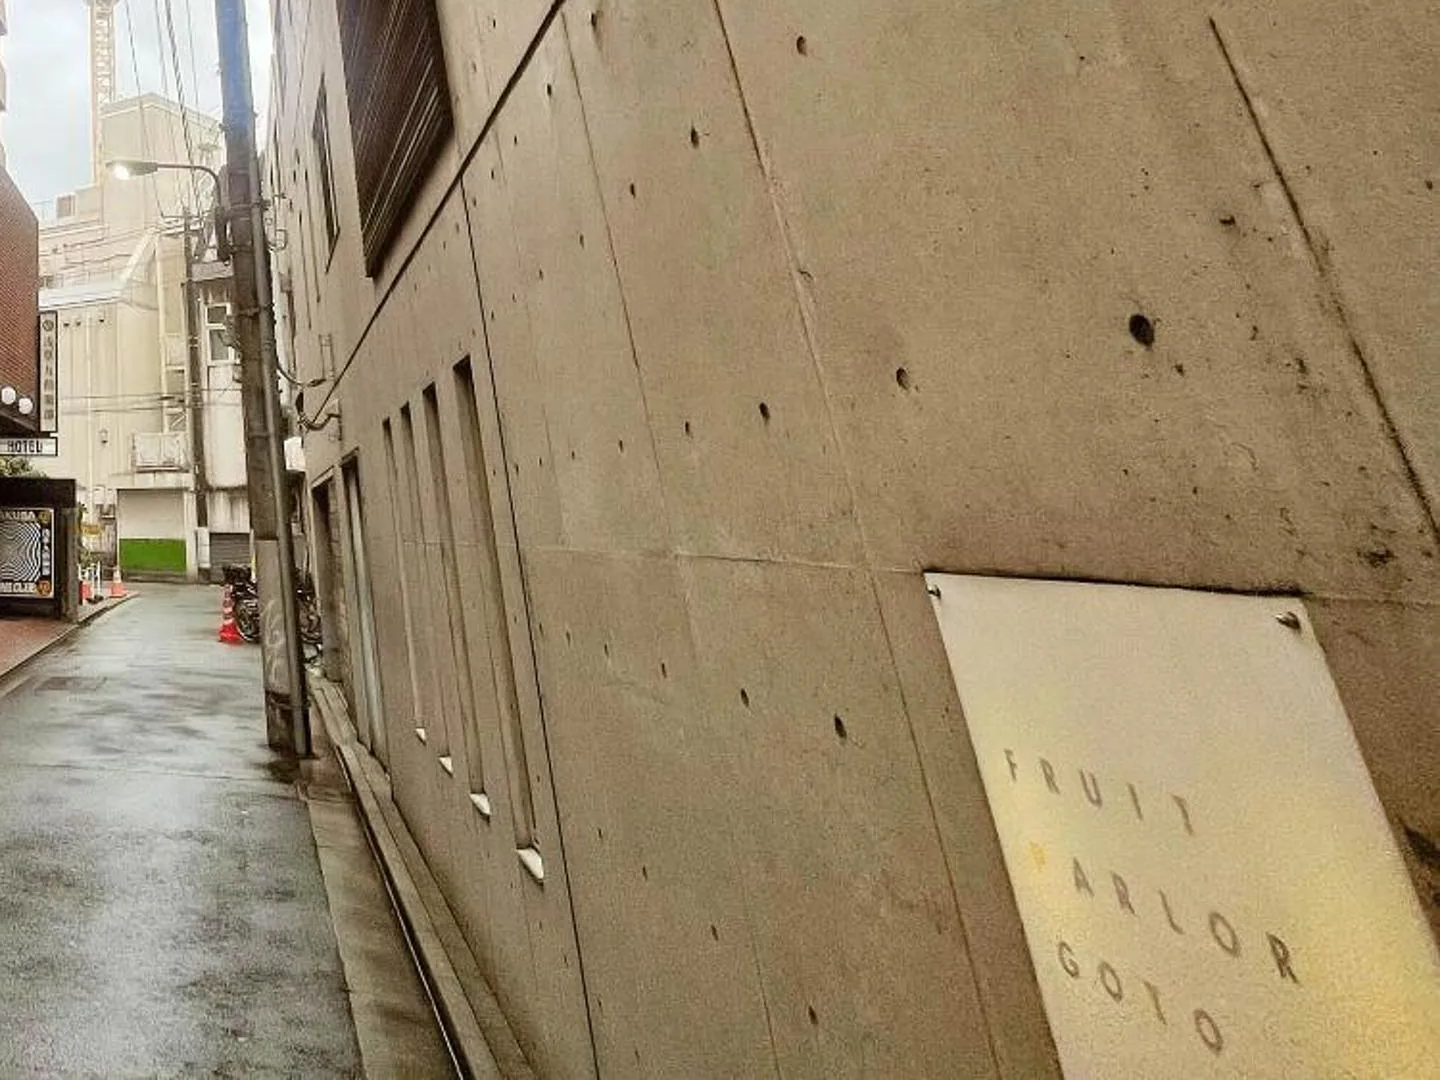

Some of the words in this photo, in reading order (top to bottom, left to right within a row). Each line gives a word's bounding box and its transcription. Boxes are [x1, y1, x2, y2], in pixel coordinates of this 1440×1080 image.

[6, 440, 43, 453] HOTEL
[1003, 748, 1196, 836] FRUIT
[1058, 941, 1224, 1056] GOTO
